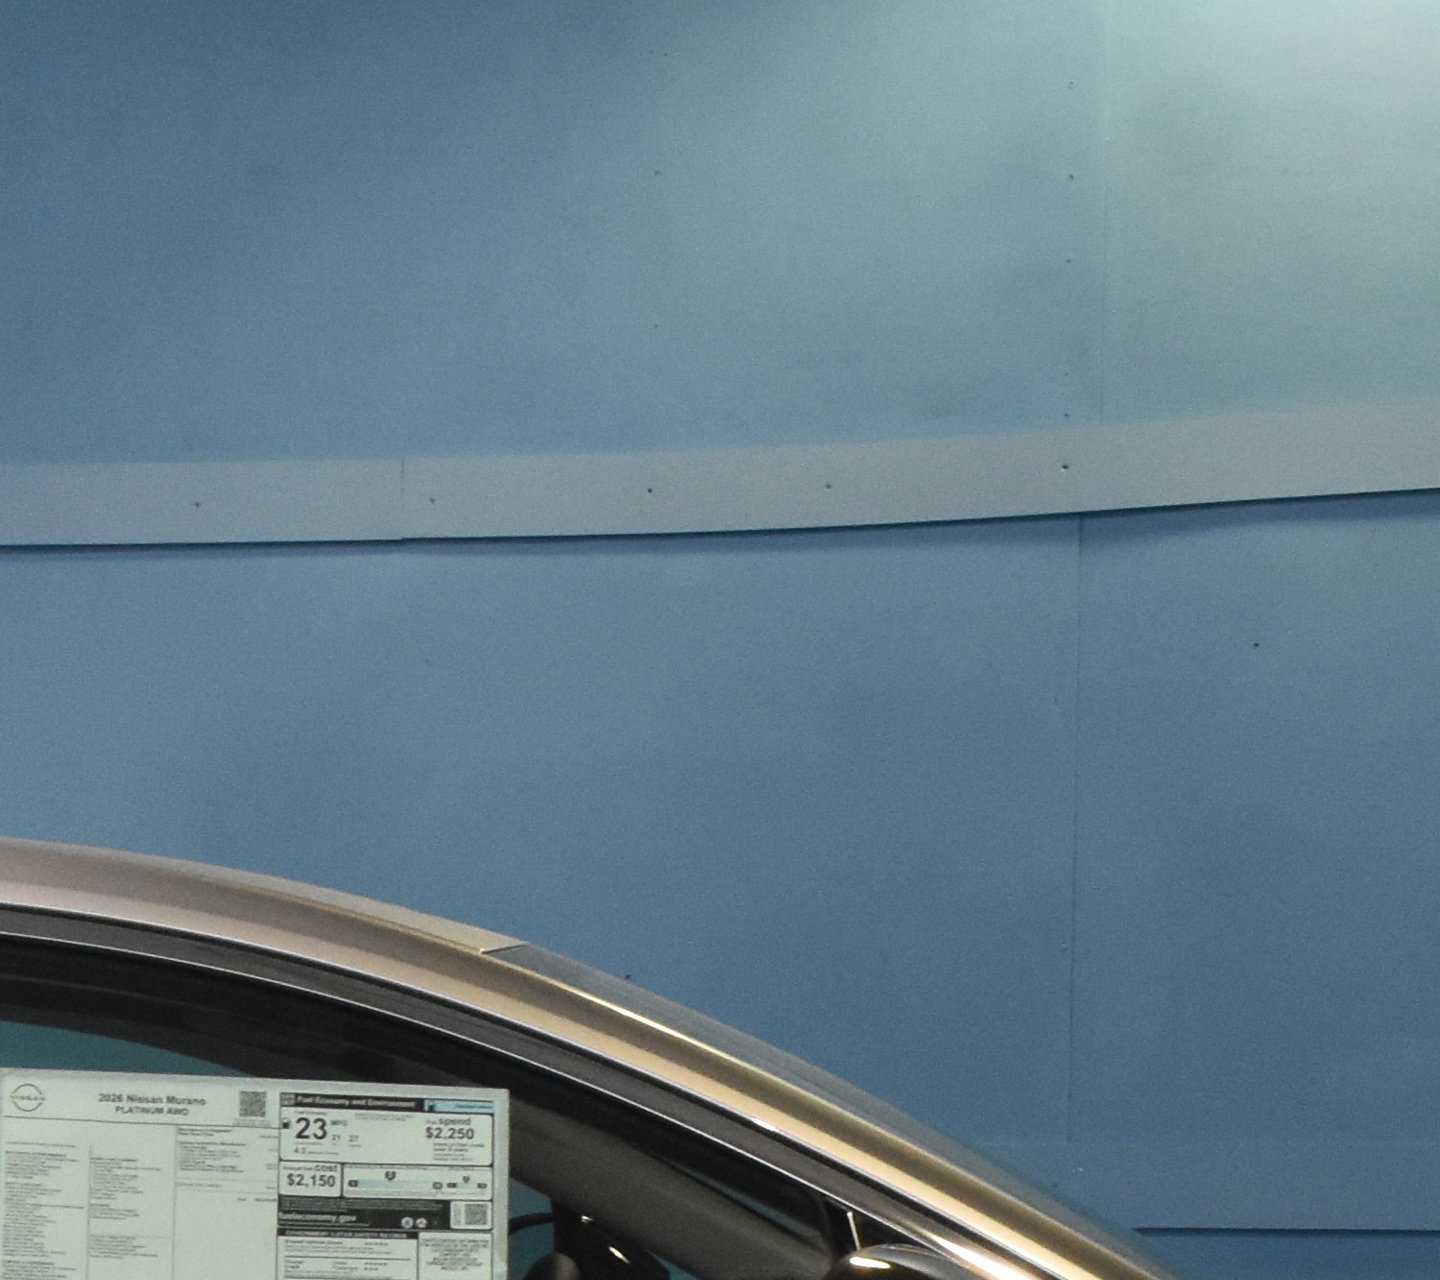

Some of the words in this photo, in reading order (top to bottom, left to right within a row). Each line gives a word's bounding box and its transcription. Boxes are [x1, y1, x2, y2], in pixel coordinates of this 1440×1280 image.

[98, 1093, 123, 1103] 2026
[127, 1094, 163, 1105] Nissan
[166, 1095, 206, 1107] Murano
[115, 1106, 164, 1116] PLATINUM
[166, 1107, 189, 1117] AWD
[295, 1117, 327, 1140] 23
[439, 1118, 471, 1127] spend
[287, 1173, 336, 1188] $2,150
